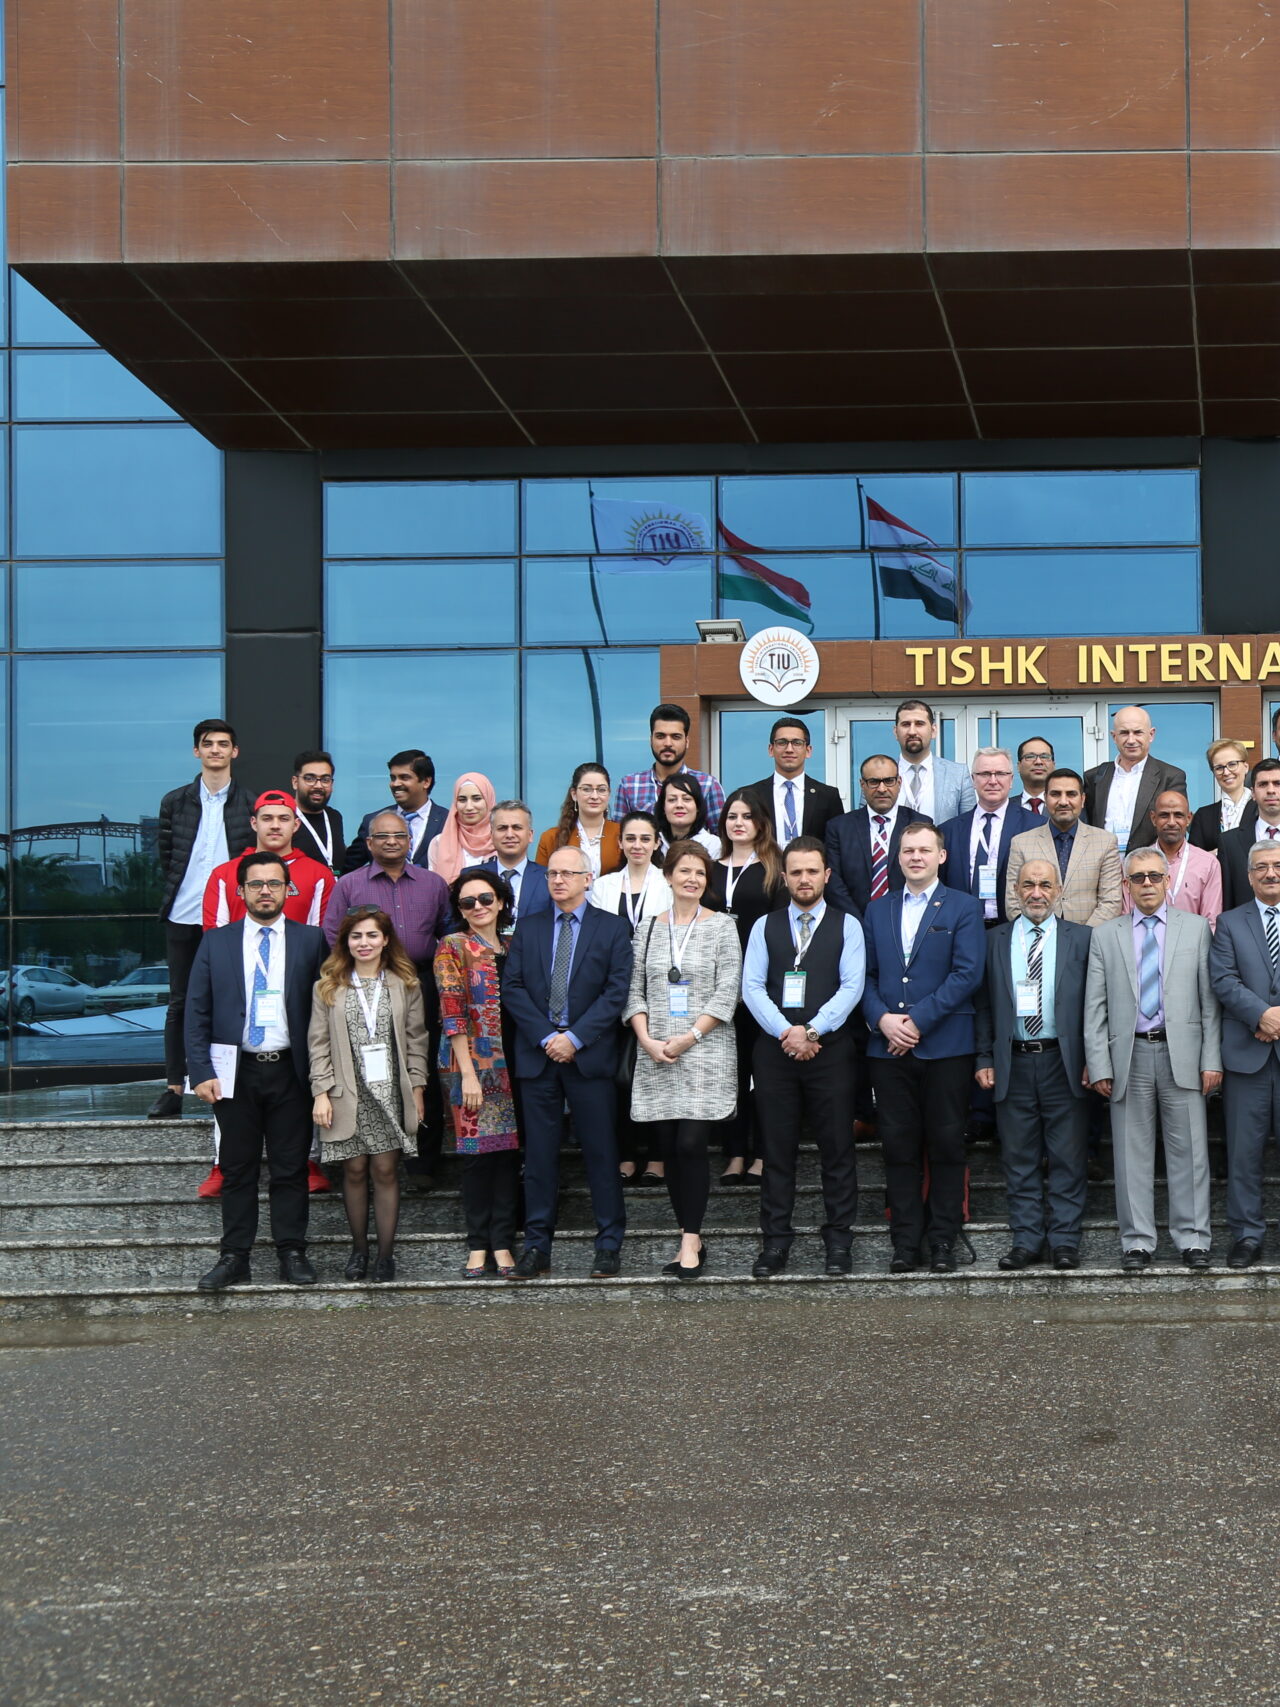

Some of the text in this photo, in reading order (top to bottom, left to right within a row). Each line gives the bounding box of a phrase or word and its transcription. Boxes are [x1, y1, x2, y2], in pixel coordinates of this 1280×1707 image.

[648, 532, 682, 551] TIU
[768, 653, 791, 670] TIU
[904, 646, 1047, 686] TISHK
